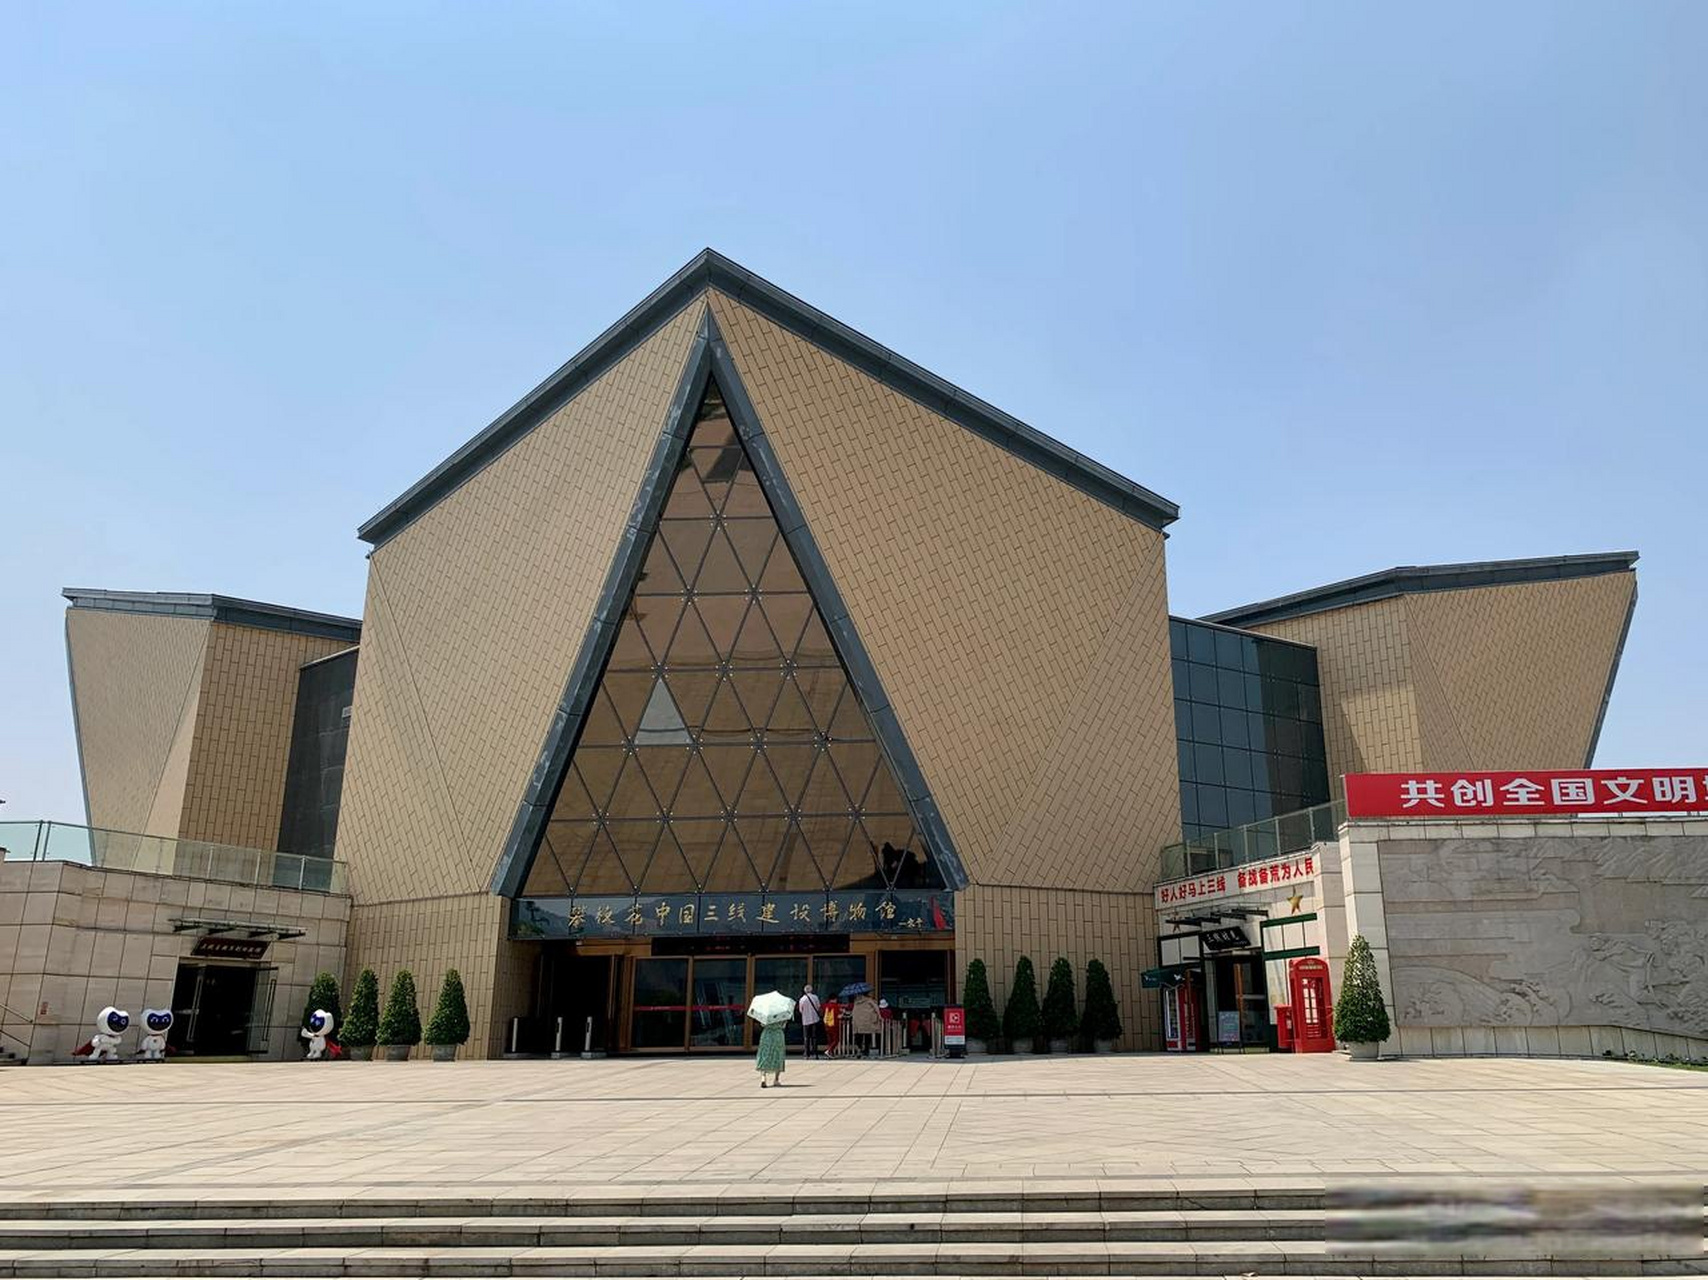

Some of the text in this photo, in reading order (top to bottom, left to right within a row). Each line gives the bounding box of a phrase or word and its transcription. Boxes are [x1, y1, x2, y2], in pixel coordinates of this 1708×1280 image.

[1400, 776, 1708, 809] 共创全国文明
[1161, 857, 1314, 903] 好人好马上三线 备战备荒为人民
[568, 900, 897, 927] 攀枝花中国三线建设博物馆
